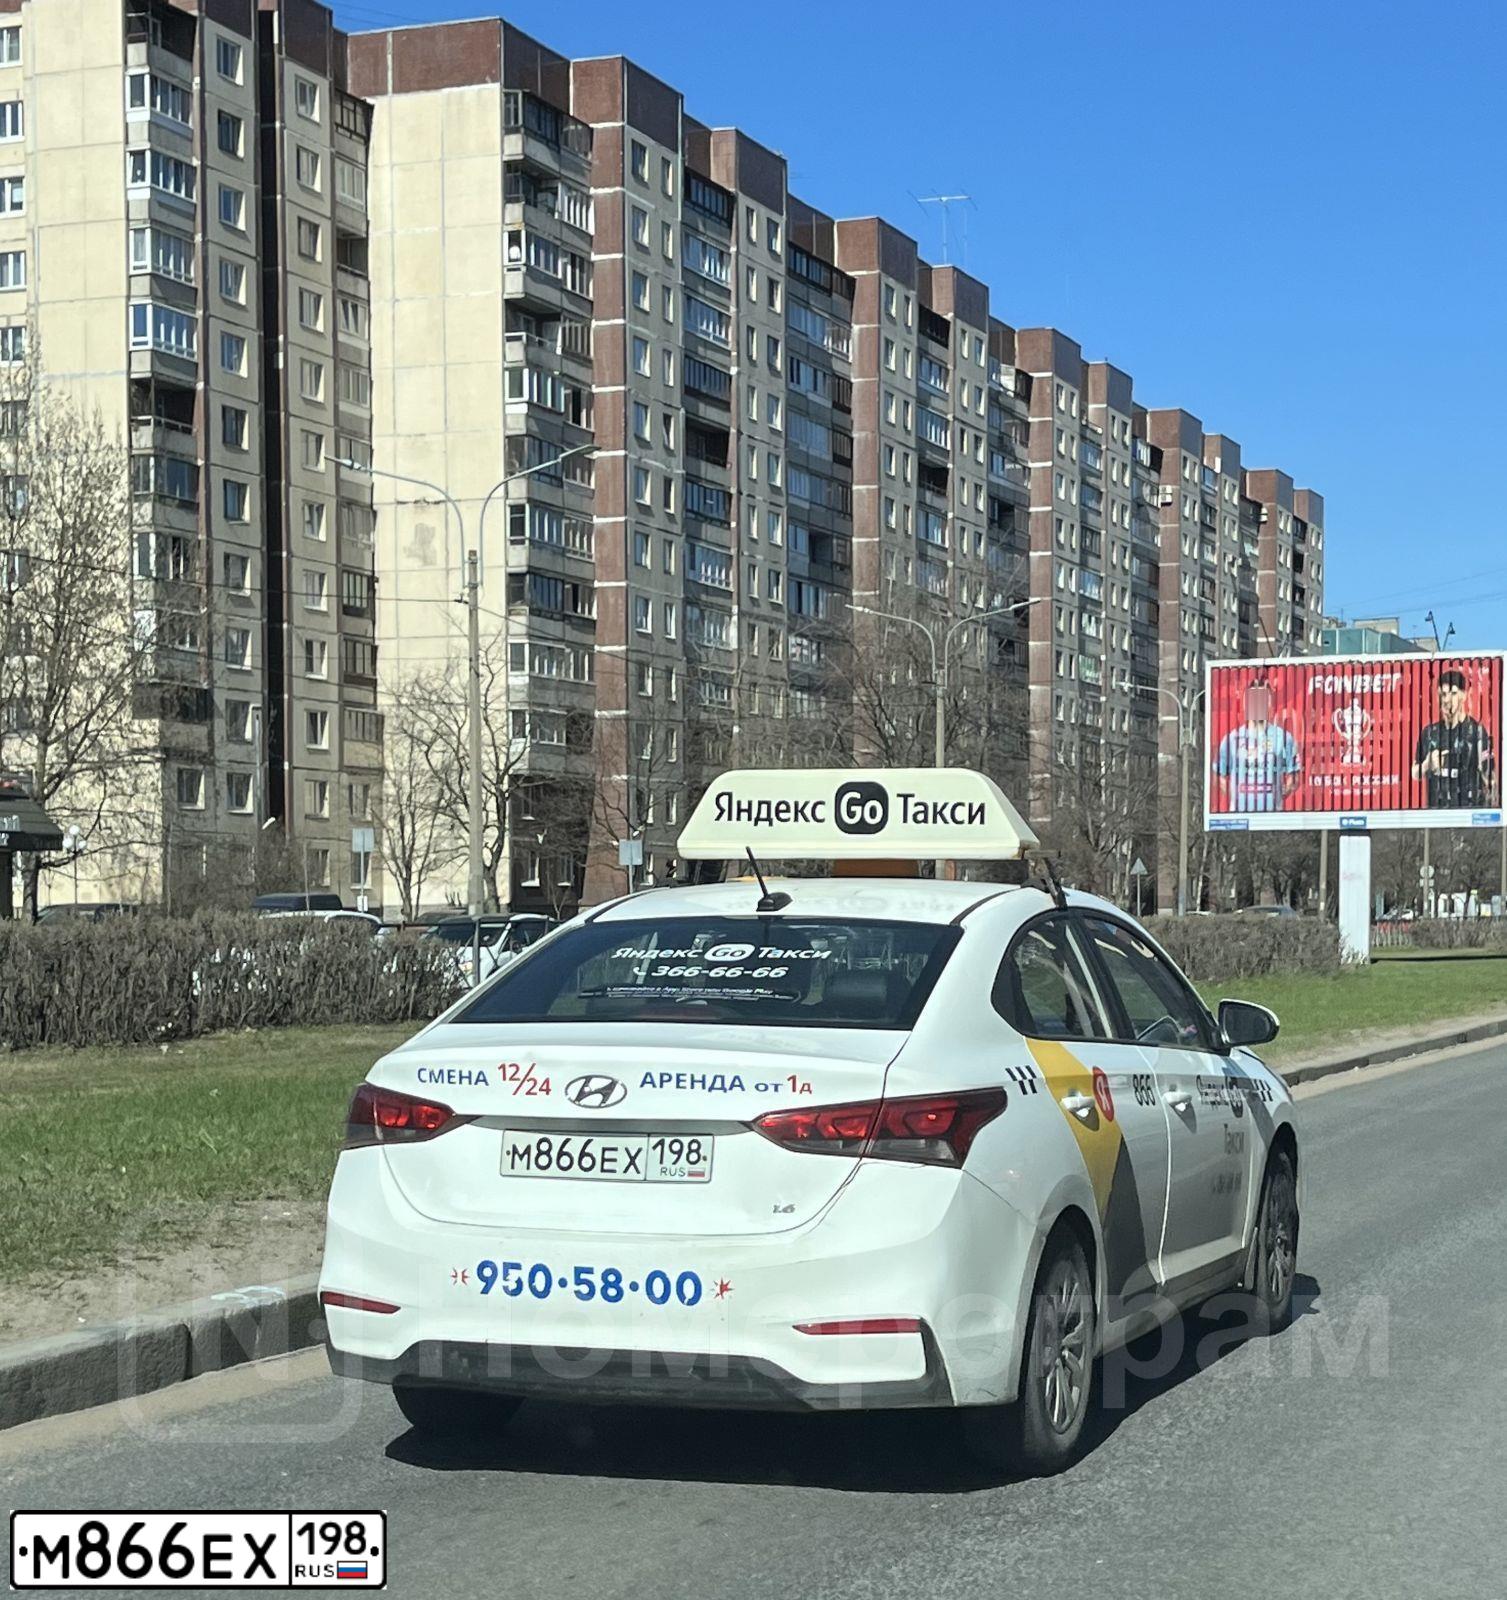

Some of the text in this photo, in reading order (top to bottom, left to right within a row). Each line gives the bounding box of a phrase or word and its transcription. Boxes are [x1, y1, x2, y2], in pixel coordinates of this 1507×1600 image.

[714, 791, 986, 827] Яндекс Go Такси
[611, 947, 703, 960] Яндекс
[758, 946, 832, 960] Такси
[651, 965, 789, 978] 366-66-66
[417, 1063, 552, 1097] СМЕНА 12/24
[639, 1071, 746, 1093] АРЕНДА
[754, 1081, 783, 1093] от
[1132, 1073, 1156, 1107] 866
[652, 1138, 702, 1166] 198
[660, 1166, 686, 1178] RUS
